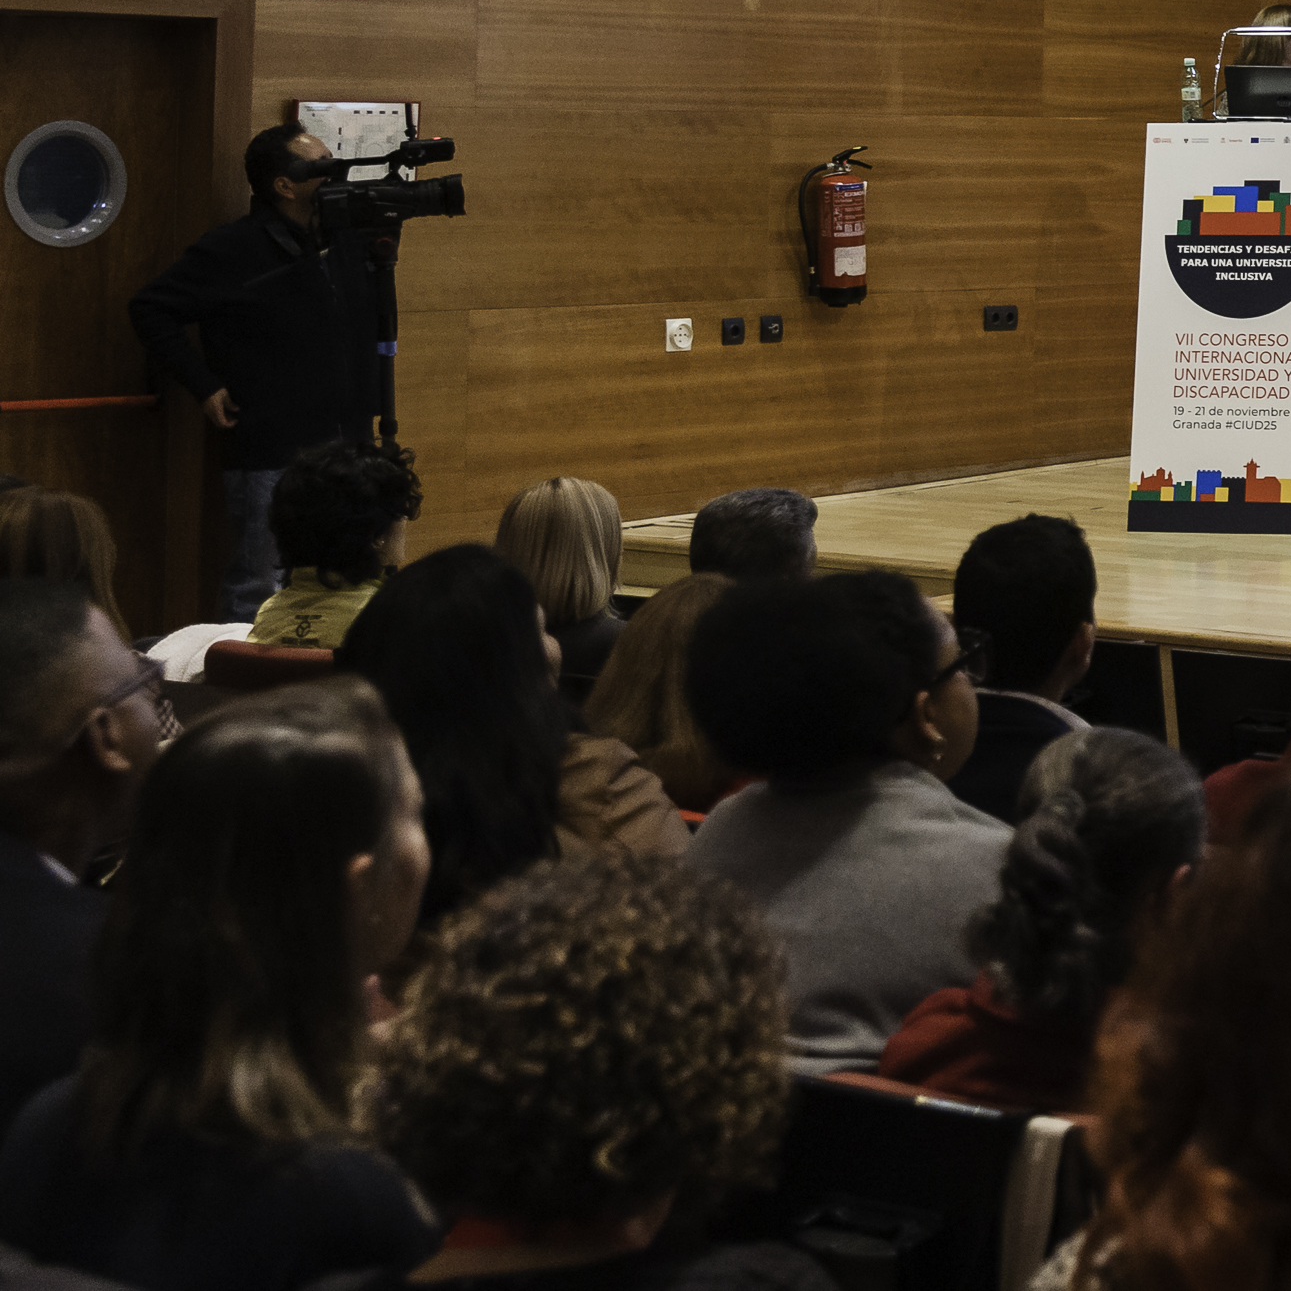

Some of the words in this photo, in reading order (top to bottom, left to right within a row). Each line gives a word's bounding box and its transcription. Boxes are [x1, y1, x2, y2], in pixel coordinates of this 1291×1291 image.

[1177, 245, 1243, 254] TENDENCIAS
[1245, 245, 1252, 254] Y
[1181, 258, 1209, 267] PARA
[1211, 258, 1233, 267] UNA
[1215, 272, 1273, 281] INCLUSIVA
[1175, 333, 1194, 346] VII
[1198, 333, 1289, 347] CONGRESO
[1173, 368, 1279, 382] UNIVERSIDAD
[1173, 385, 1290, 400] DISCAPACIDAD
[1173, 406, 1185, 416] 19
[1195, 406, 1206, 416] 21
[1208, 406, 1223, 416] de
[1226, 407, 1291, 417] noviembre
[1173, 419, 1222, 430] Granada
[1225, 420, 1277, 430] #CIUD25
